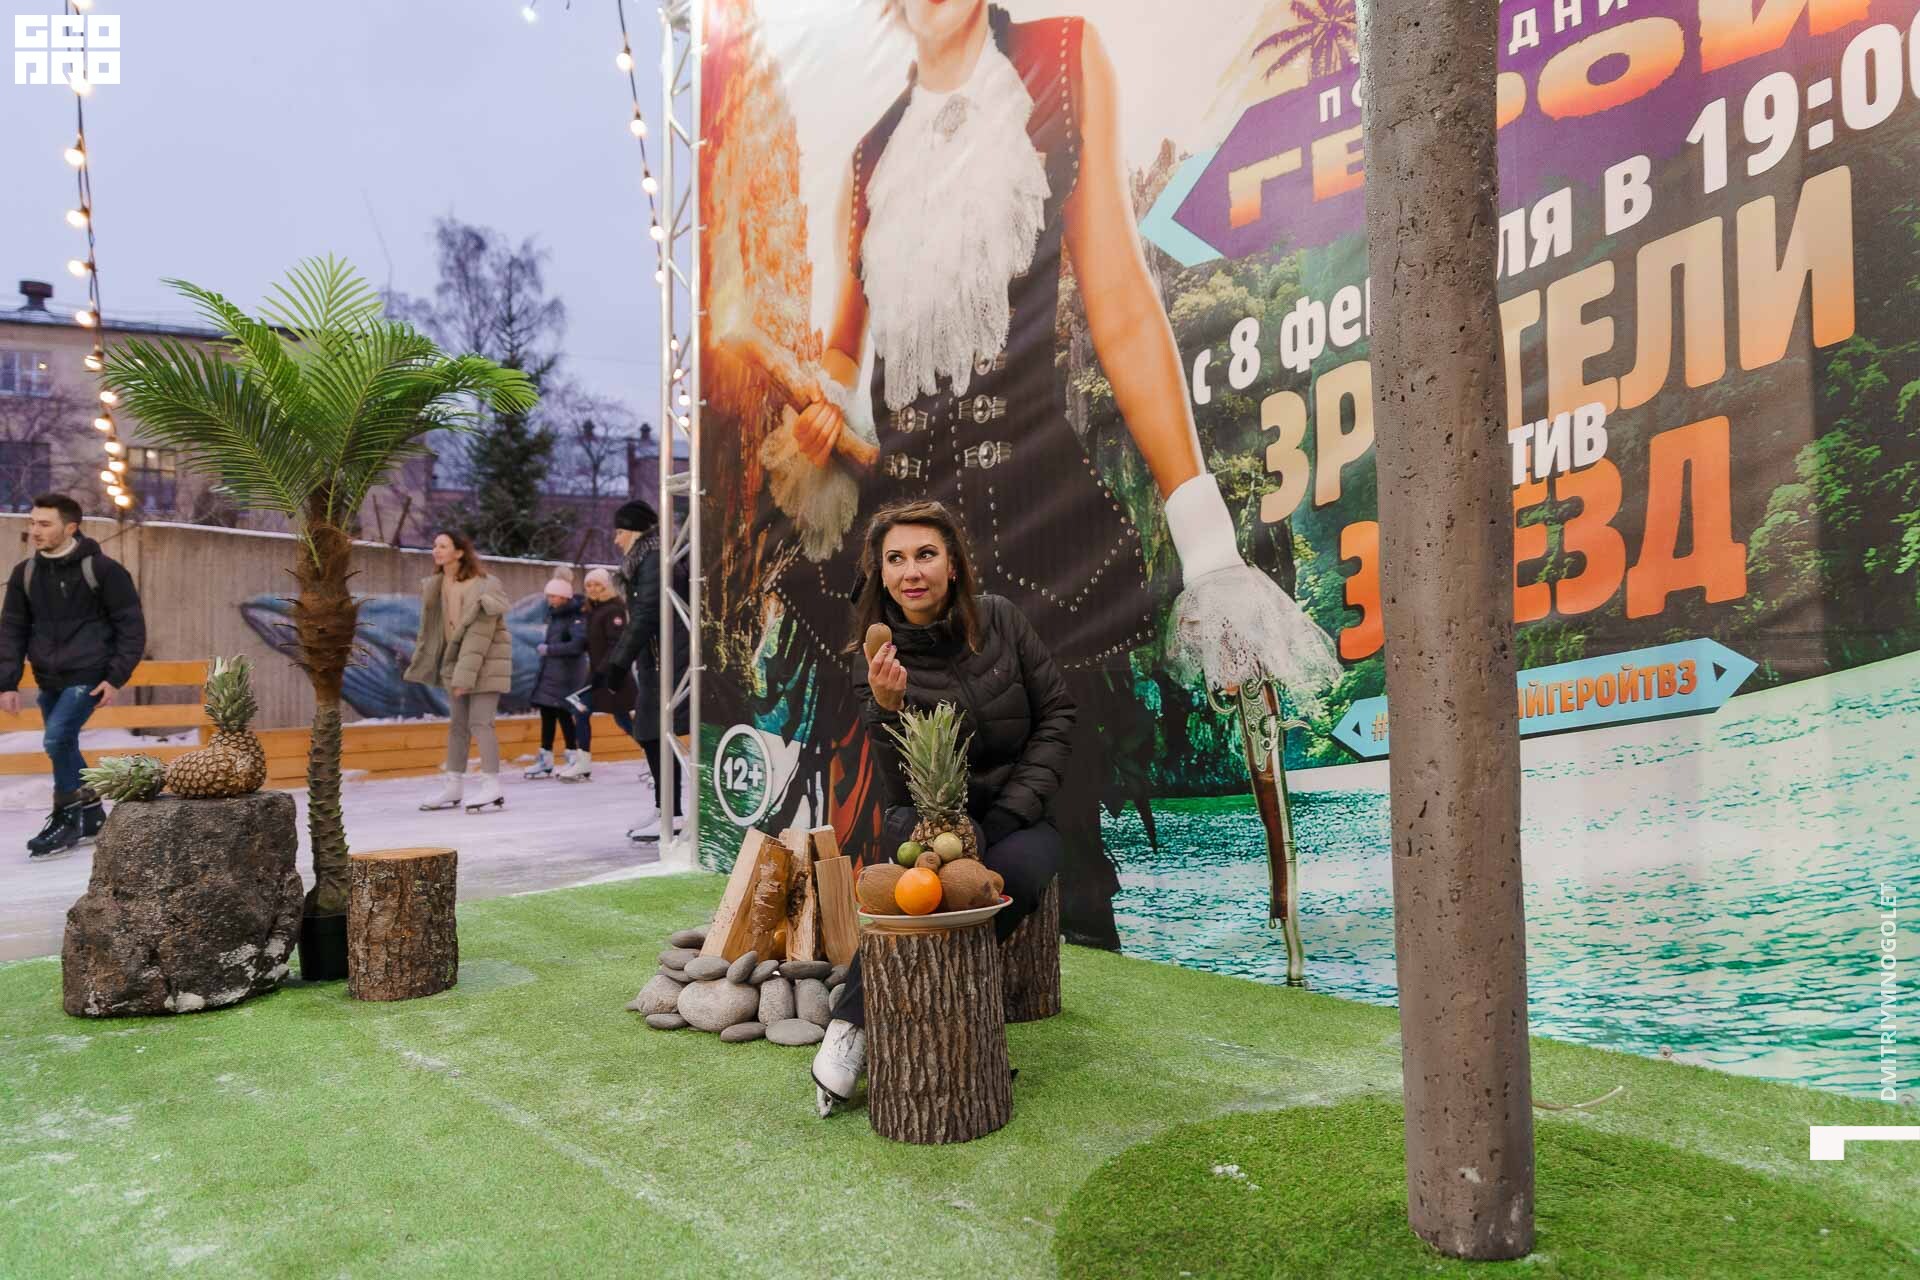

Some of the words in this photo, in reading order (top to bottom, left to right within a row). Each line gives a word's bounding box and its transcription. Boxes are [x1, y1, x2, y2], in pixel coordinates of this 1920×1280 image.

[1228, 317, 1261, 390] 8
[1686, 8, 1920, 194] 19:0
[1260, 165, 1856, 525] ЗРТЕЛИ
[722, 756, 763, 791] 12+
